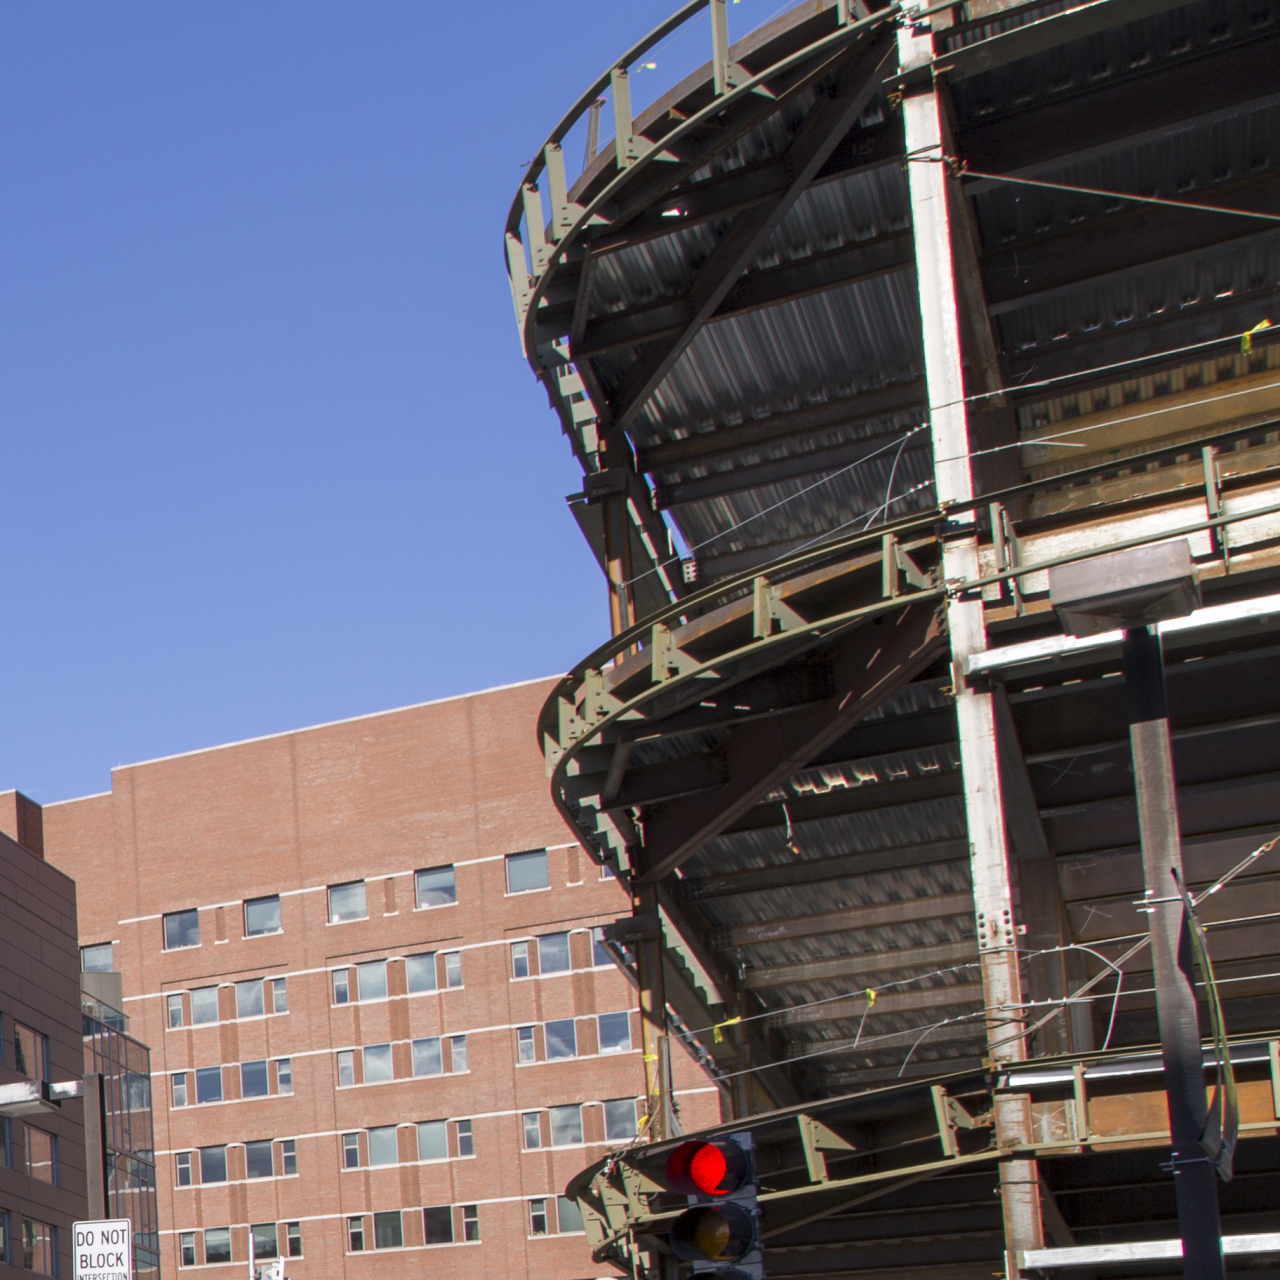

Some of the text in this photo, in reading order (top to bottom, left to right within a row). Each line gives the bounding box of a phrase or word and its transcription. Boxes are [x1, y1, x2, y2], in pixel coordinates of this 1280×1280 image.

[76, 1228, 127, 1246] DO NOT
[80, 1252, 124, 1269] BLOCK
